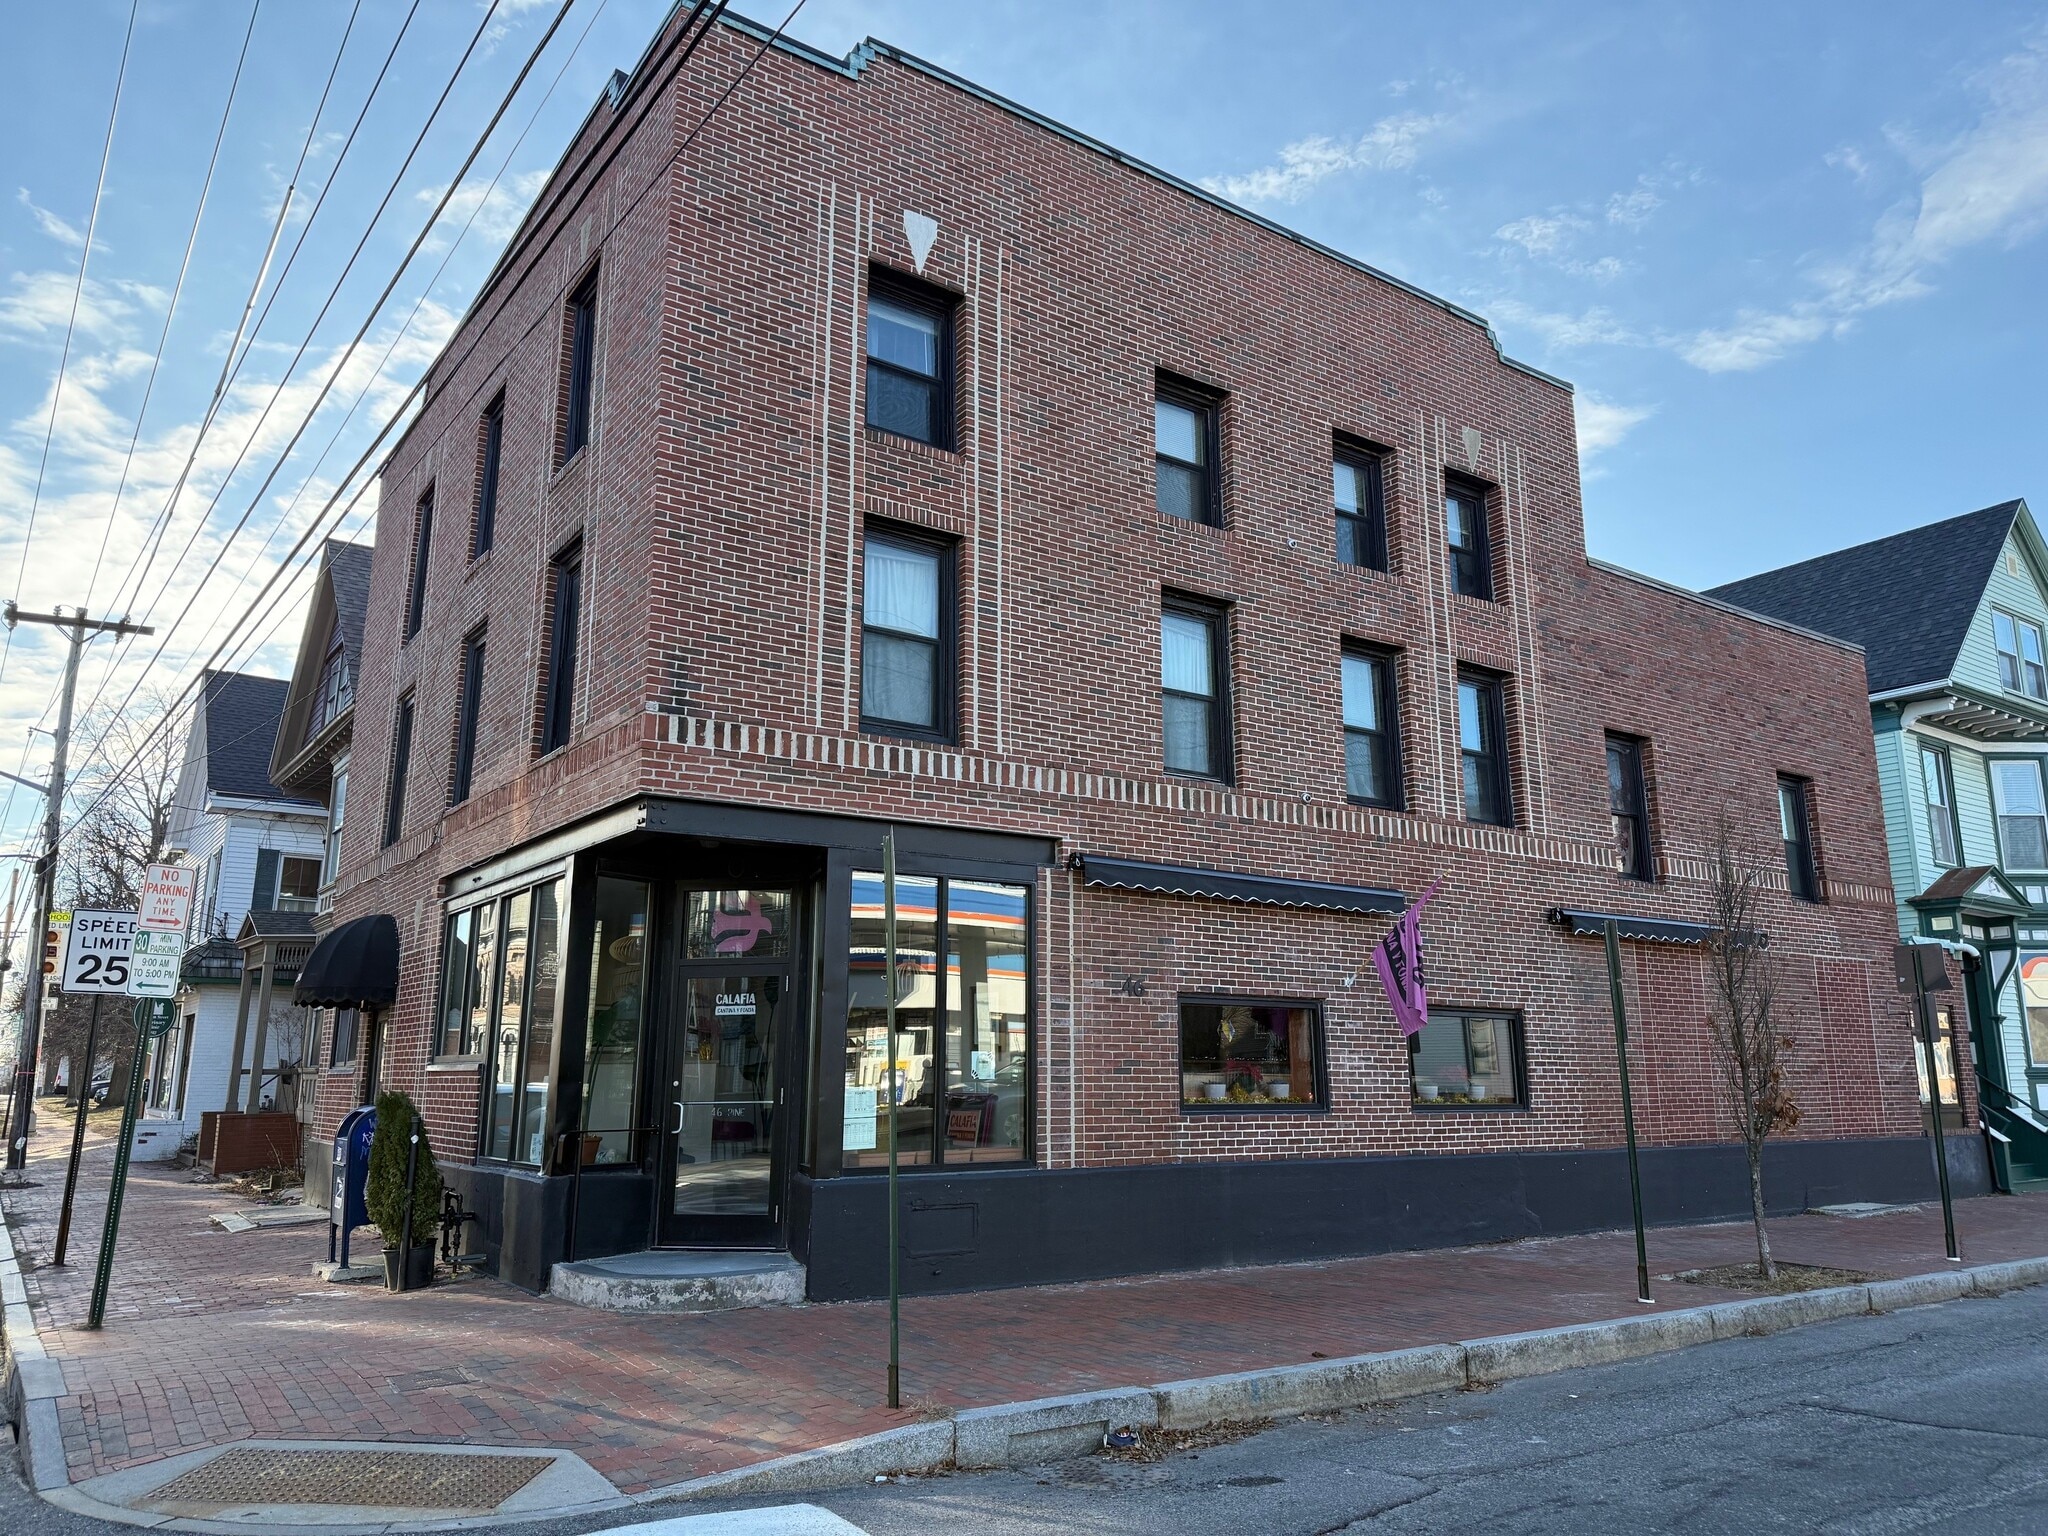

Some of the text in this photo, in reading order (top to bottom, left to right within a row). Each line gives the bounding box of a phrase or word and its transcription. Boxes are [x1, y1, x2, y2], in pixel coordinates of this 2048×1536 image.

[161, 869, 179, 882] NO
[146, 882, 189, 897] PARKING
[156, 897, 175, 906] ANY
[152, 906, 176, 916] TIME
[77, 919, 140, 934] SPEED
[82, 936, 132, 950] LIMIT
[135, 934, 172, 951] 30 MIN
[150, 944, 179, 955] PARKING
[142, 957, 169, 968] 9:00 AM
[75, 954, 129, 986] 25
[133, 968, 174, 979] TO 5:00 PM
[1122, 975, 1145, 997] 46
[716, 993, 756, 1004] CALAFIA
